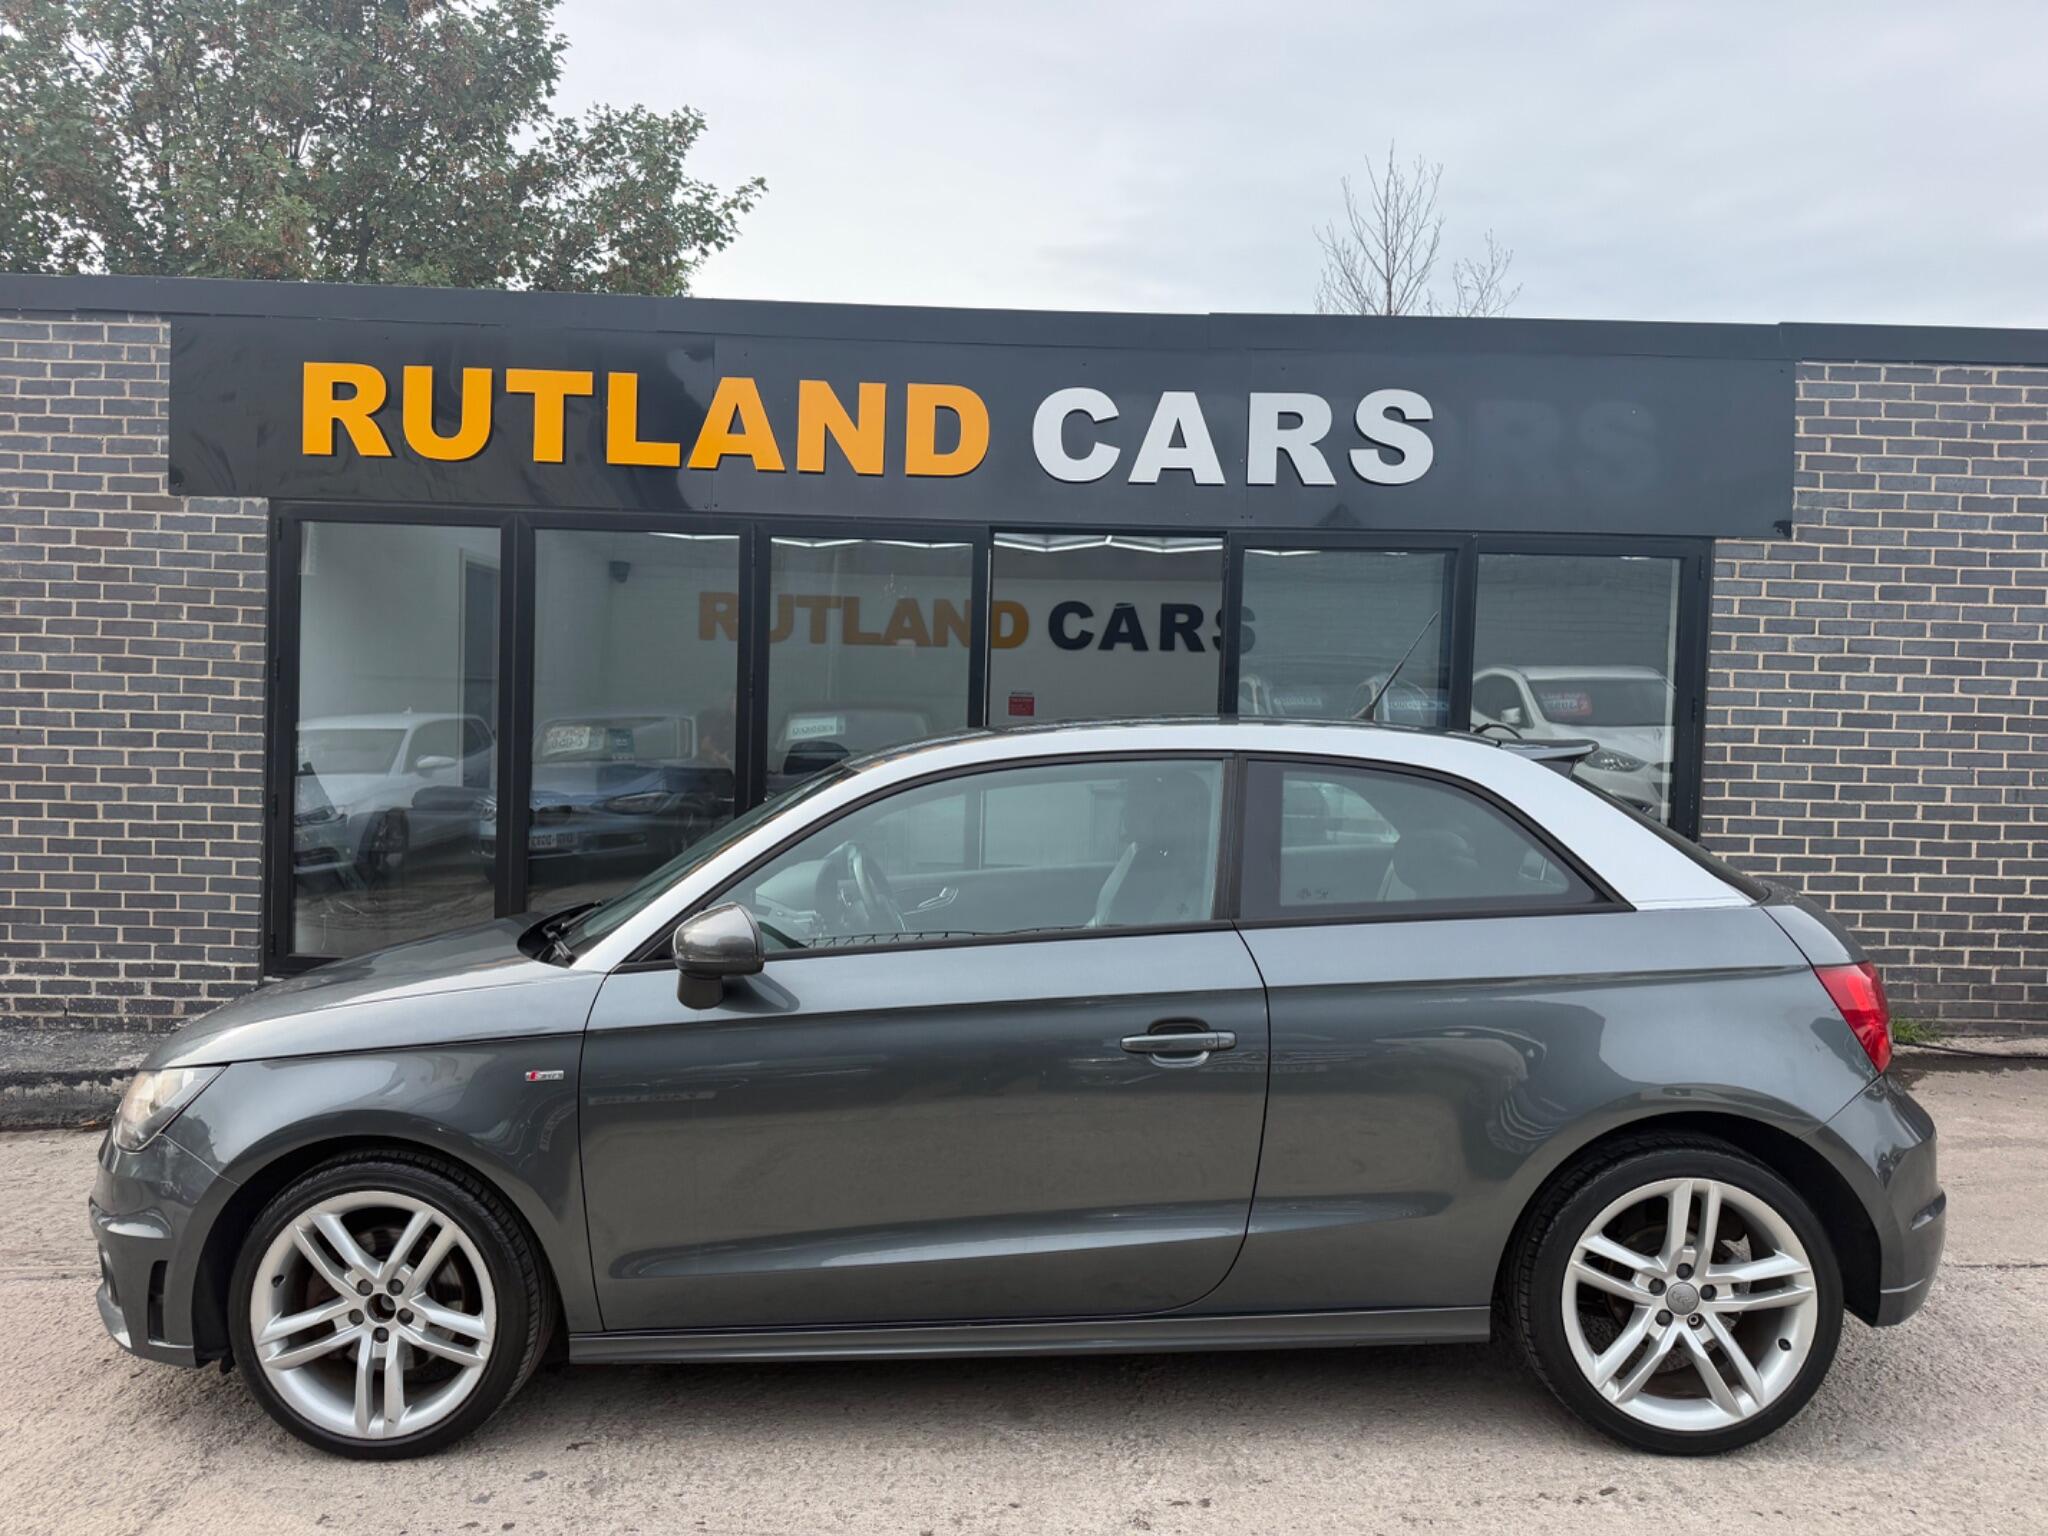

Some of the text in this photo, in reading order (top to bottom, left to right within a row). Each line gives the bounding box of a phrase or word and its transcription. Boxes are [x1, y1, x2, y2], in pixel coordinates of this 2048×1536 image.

[302, 362, 990, 477] RUTLAND
[1032, 387, 1434, 485] CARS
[699, 591, 1256, 655] RUTLAND CARS
